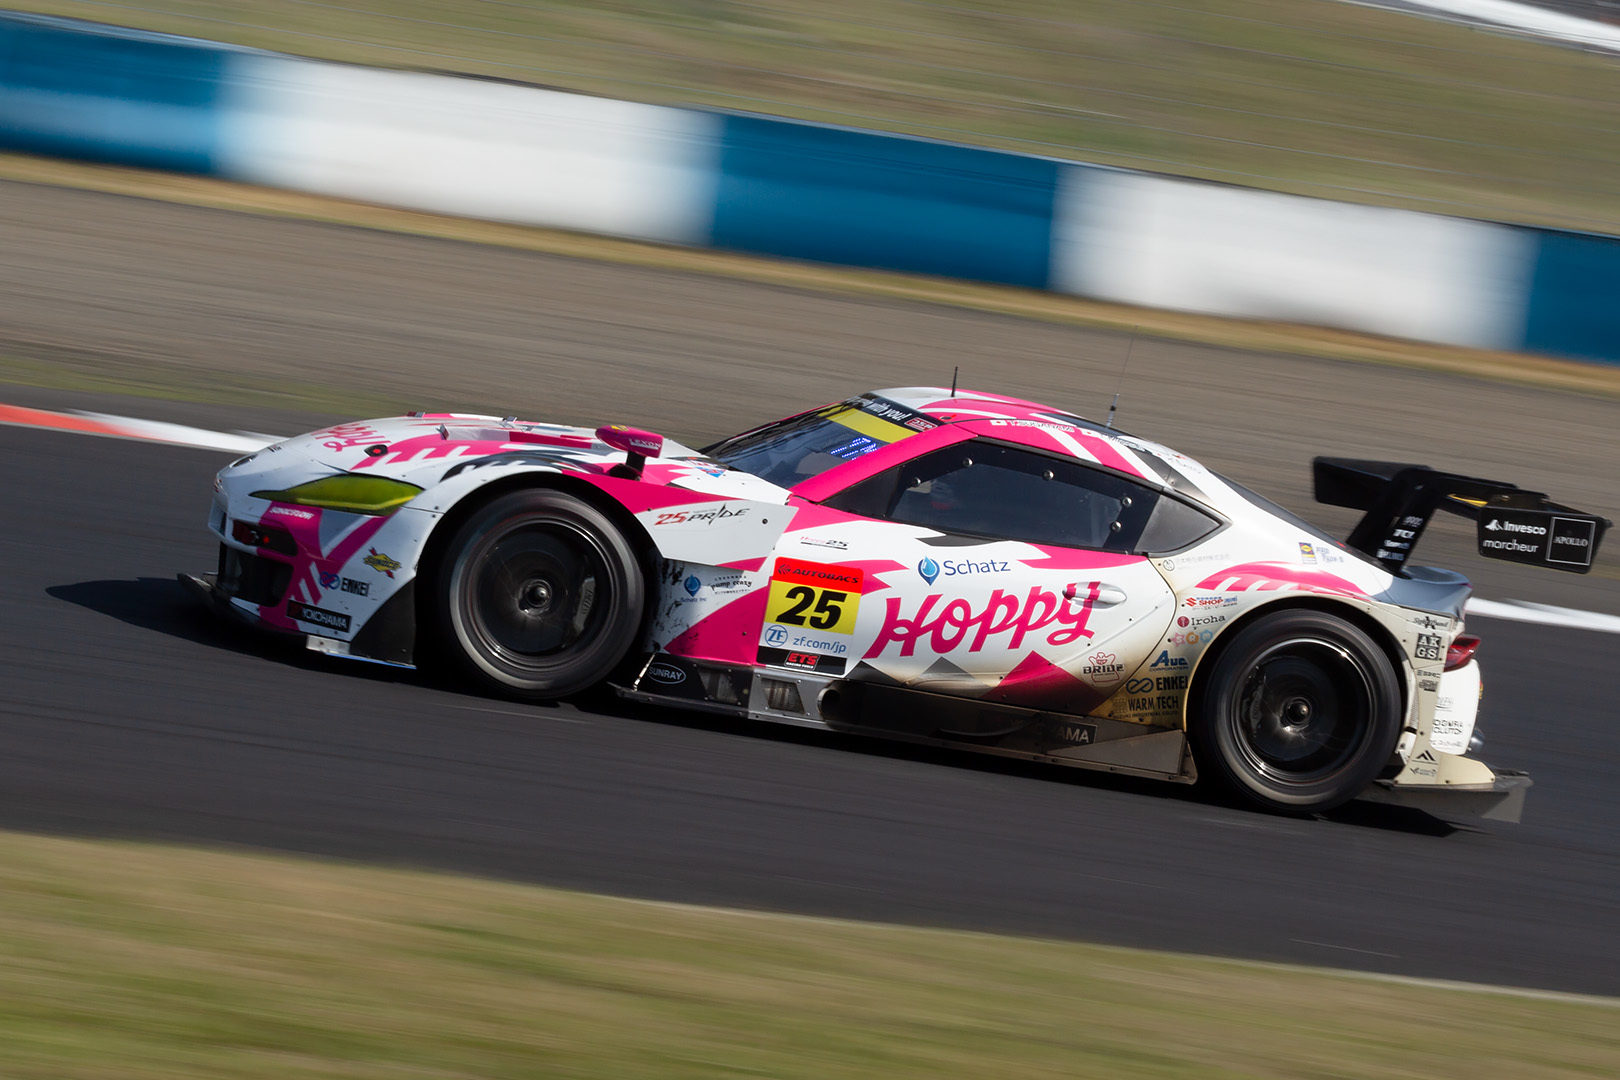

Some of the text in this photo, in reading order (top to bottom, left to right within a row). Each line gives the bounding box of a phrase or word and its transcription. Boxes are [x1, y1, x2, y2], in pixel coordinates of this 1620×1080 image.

[878, 408, 913, 422] you!
[628, 437, 662, 449] LEXON
[655, 503, 751, 526] 25 PRIDE
[1503, 520, 1547, 536] Invesco
[1482, 537, 1540, 554] marcheur
[1554, 535, 1589, 548] APOLLO
[366, 555, 401, 571] SUNOCO
[943, 558, 1011, 576] Schatz
[793, 567, 859, 583] AUTOBACS
[340, 577, 370, 597] ENKEI
[775, 586, 848, 630] 25
[1198, 598, 1225, 606] SHOP
[301, 606, 348, 629] YOKOHAMA
[861, 581, 1102, 660] Hoppy
[1191, 615, 1226, 626] Iroha
[766, 628, 847, 654] ZF zf.com/jp
[788, 652, 818, 666] ETS
[648, 666, 683, 680] SUNRAY
[1156, 675, 1189, 691] ENKEI
[1127, 695, 1179, 712] WARM TECH
